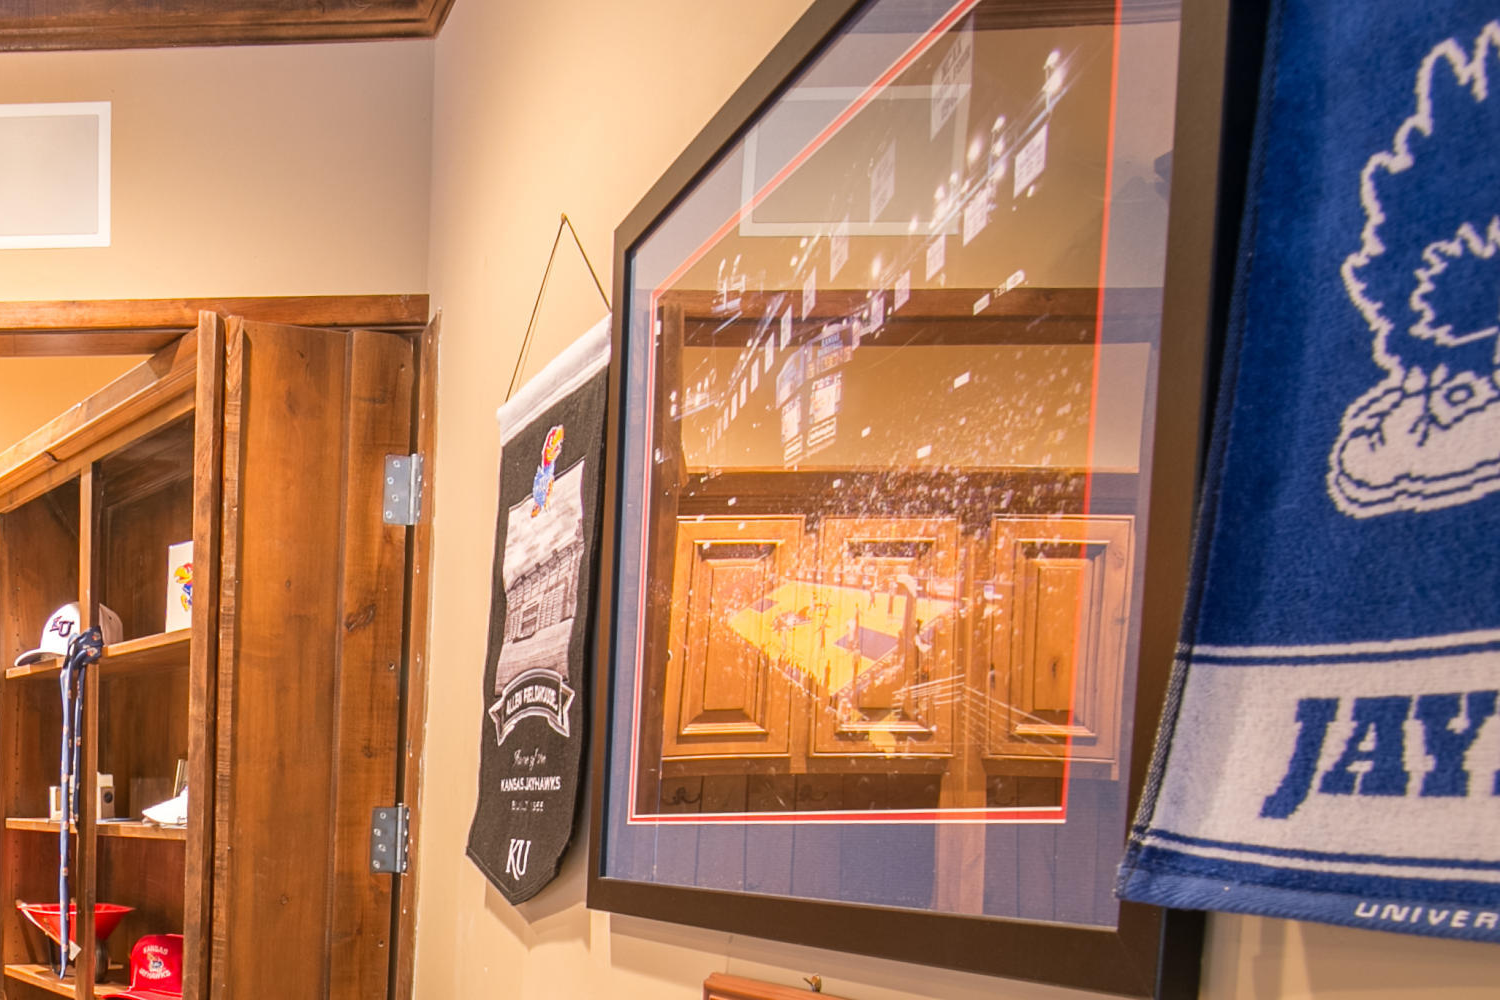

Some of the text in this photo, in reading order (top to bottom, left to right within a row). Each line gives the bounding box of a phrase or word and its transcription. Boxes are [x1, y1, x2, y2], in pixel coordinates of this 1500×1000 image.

[1259, 690, 1500, 820] JAY
[500, 775, 561, 792] KANSAS JAYHAWKS
[505, 838, 532, 880] KU
